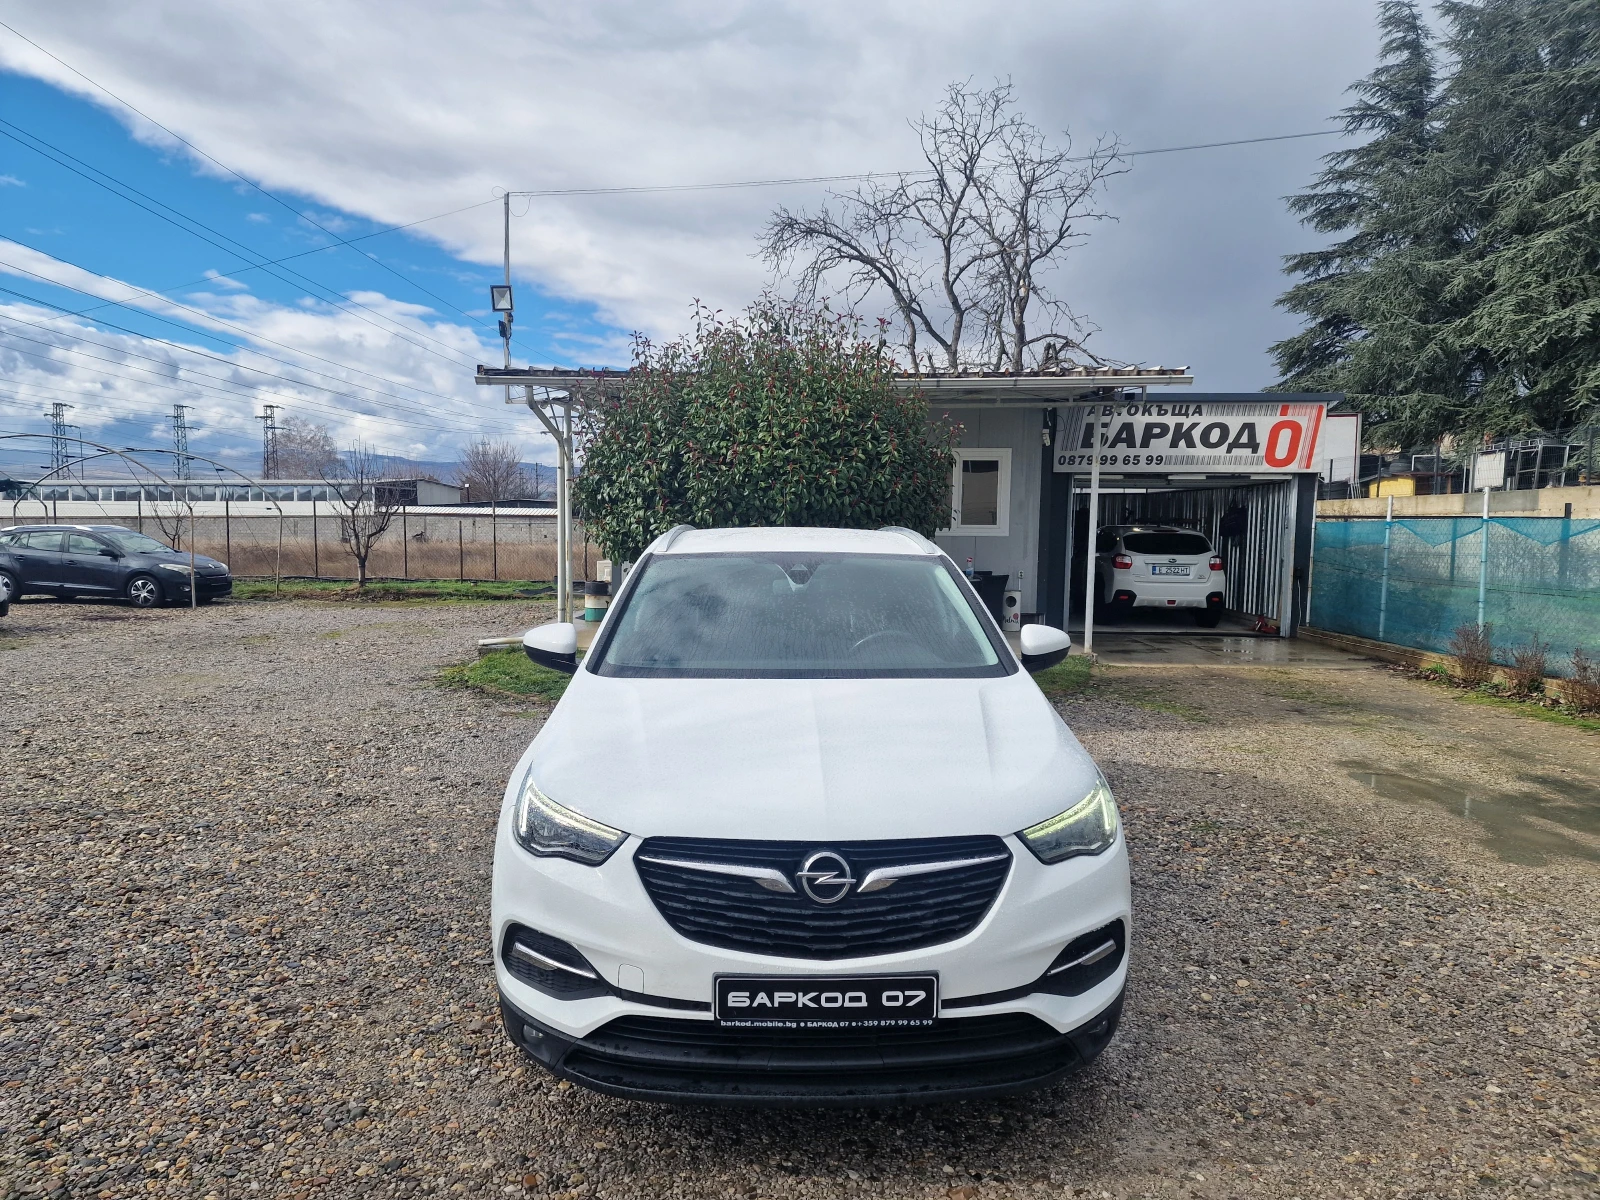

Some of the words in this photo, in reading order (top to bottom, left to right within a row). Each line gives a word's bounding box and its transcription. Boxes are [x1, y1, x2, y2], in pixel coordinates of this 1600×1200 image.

[1080, 422, 1260, 454] БАРКОД
[1058, 455, 1093, 465] 0879
[1099, 455, 1118, 465] 99
[1122, 455, 1141, 465] 65
[1145, 455, 1164, 465] 99
[728, 992, 868, 1007] БАРКОД
[882, 991, 926, 1006] 07
[720, 1020, 797, 1028] barkod.mobile.bg
